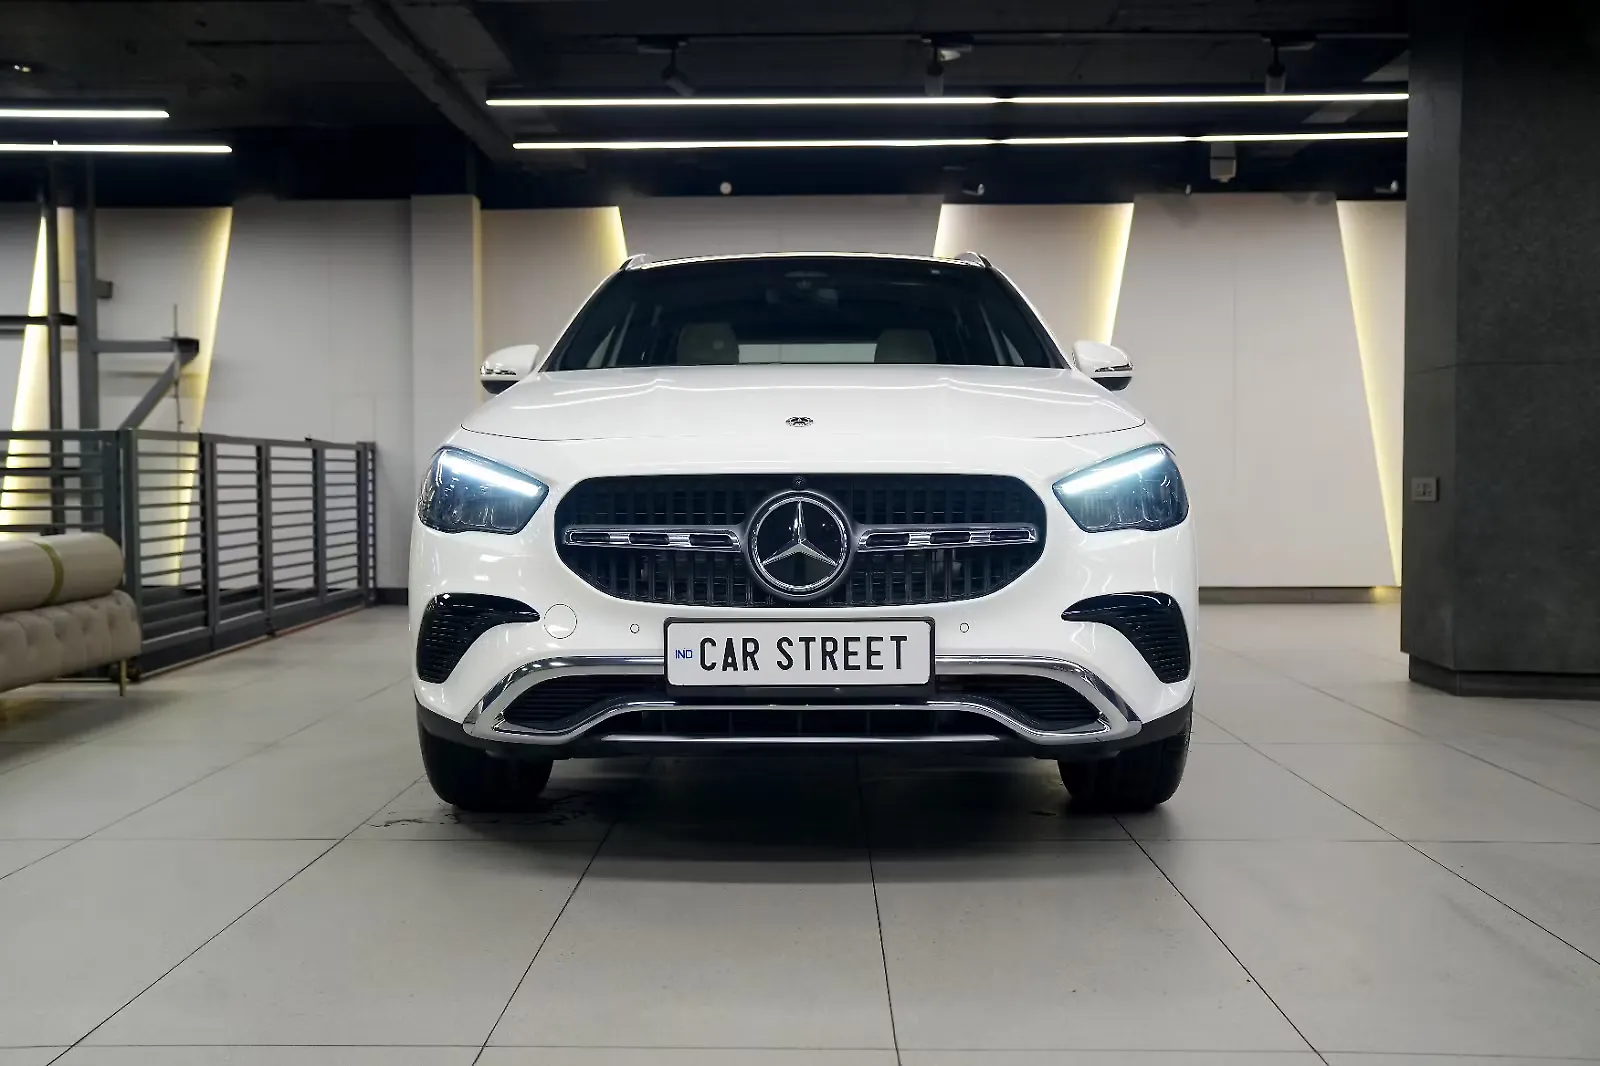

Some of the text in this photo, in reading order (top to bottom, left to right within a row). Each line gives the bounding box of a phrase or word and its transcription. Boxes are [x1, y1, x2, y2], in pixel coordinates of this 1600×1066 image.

[675, 649, 693, 659] IND
[700, 636, 907, 671] CAR STREET
